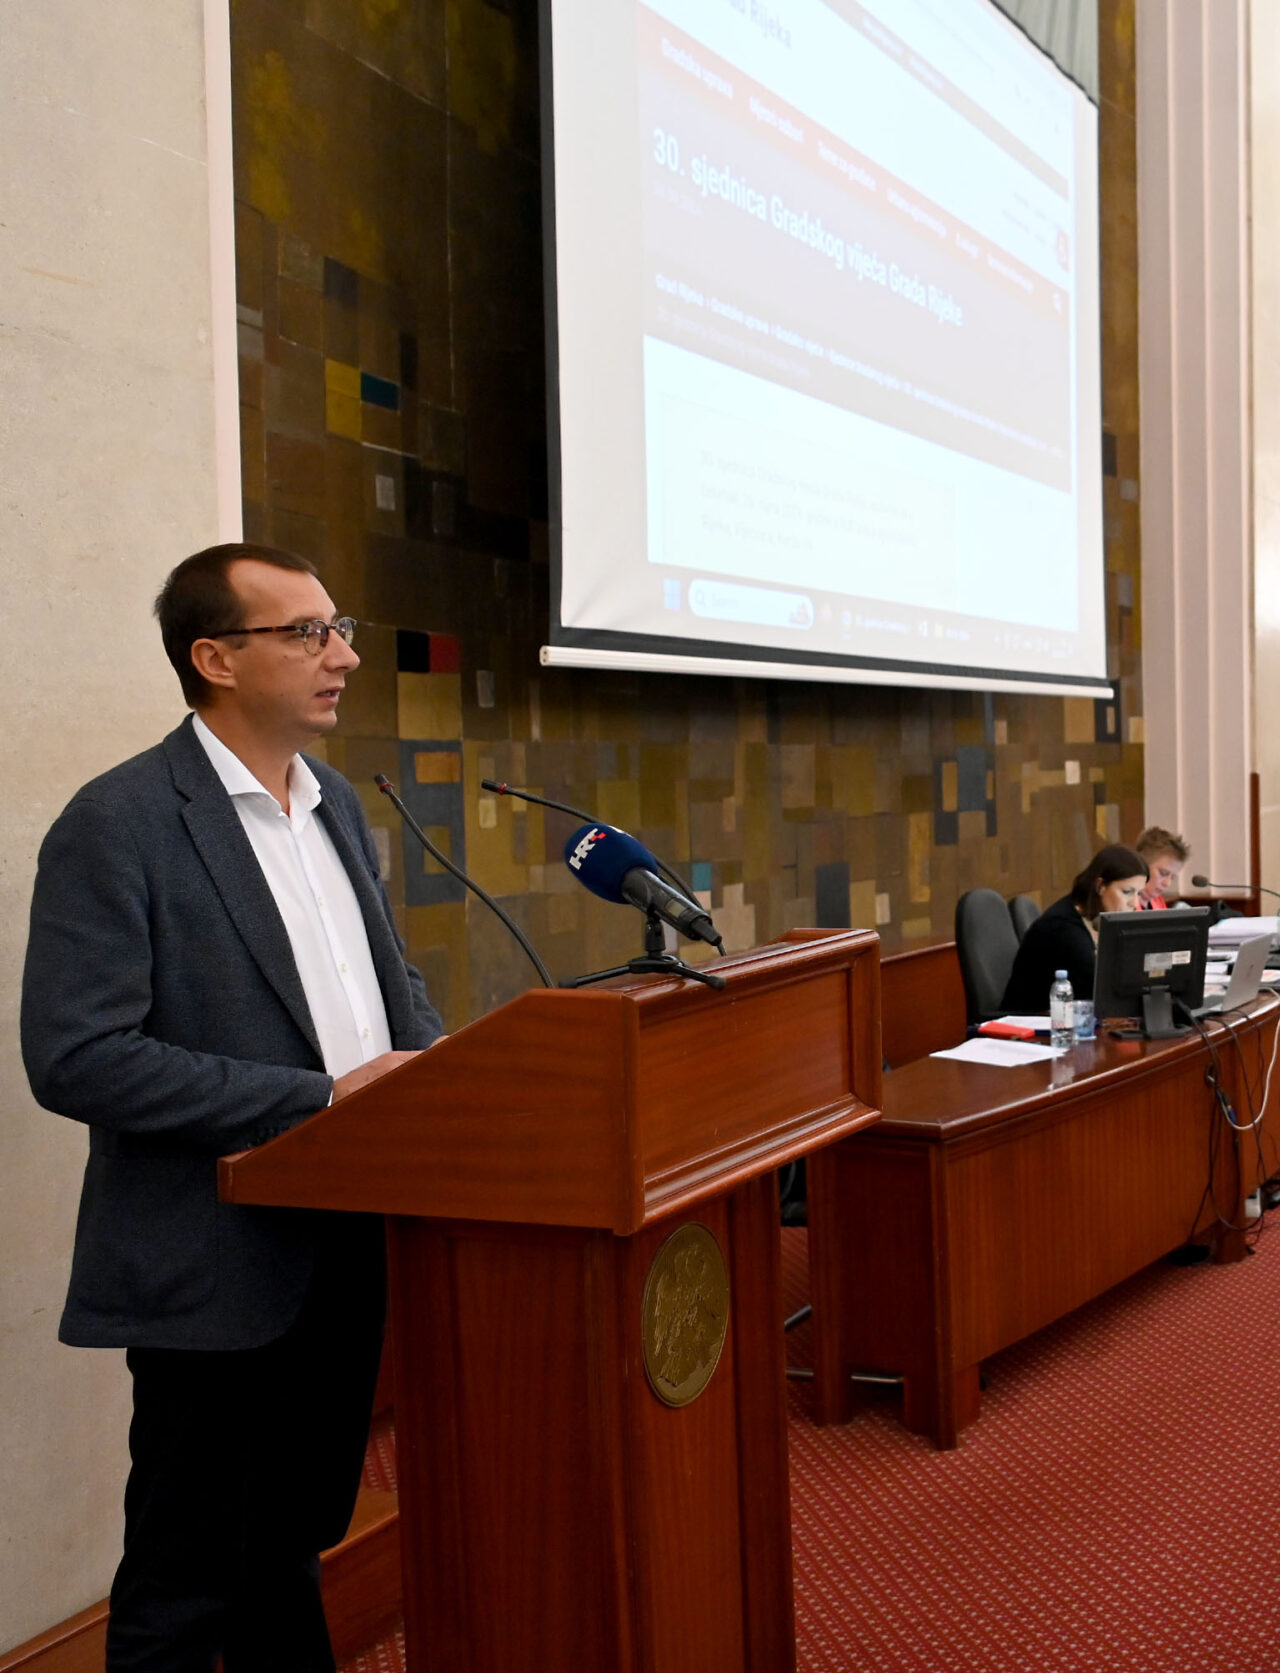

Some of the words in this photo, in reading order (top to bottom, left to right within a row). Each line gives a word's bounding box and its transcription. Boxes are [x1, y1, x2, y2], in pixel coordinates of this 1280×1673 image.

[653, 127, 686, 177] 30.
[691, 154, 767, 221] sjednica
[771, 194, 845, 271] Gradskog
[848, 240, 887, 281] vijeća
[889, 262, 927, 307] Grada
[569, 828, 606, 870] HRT
